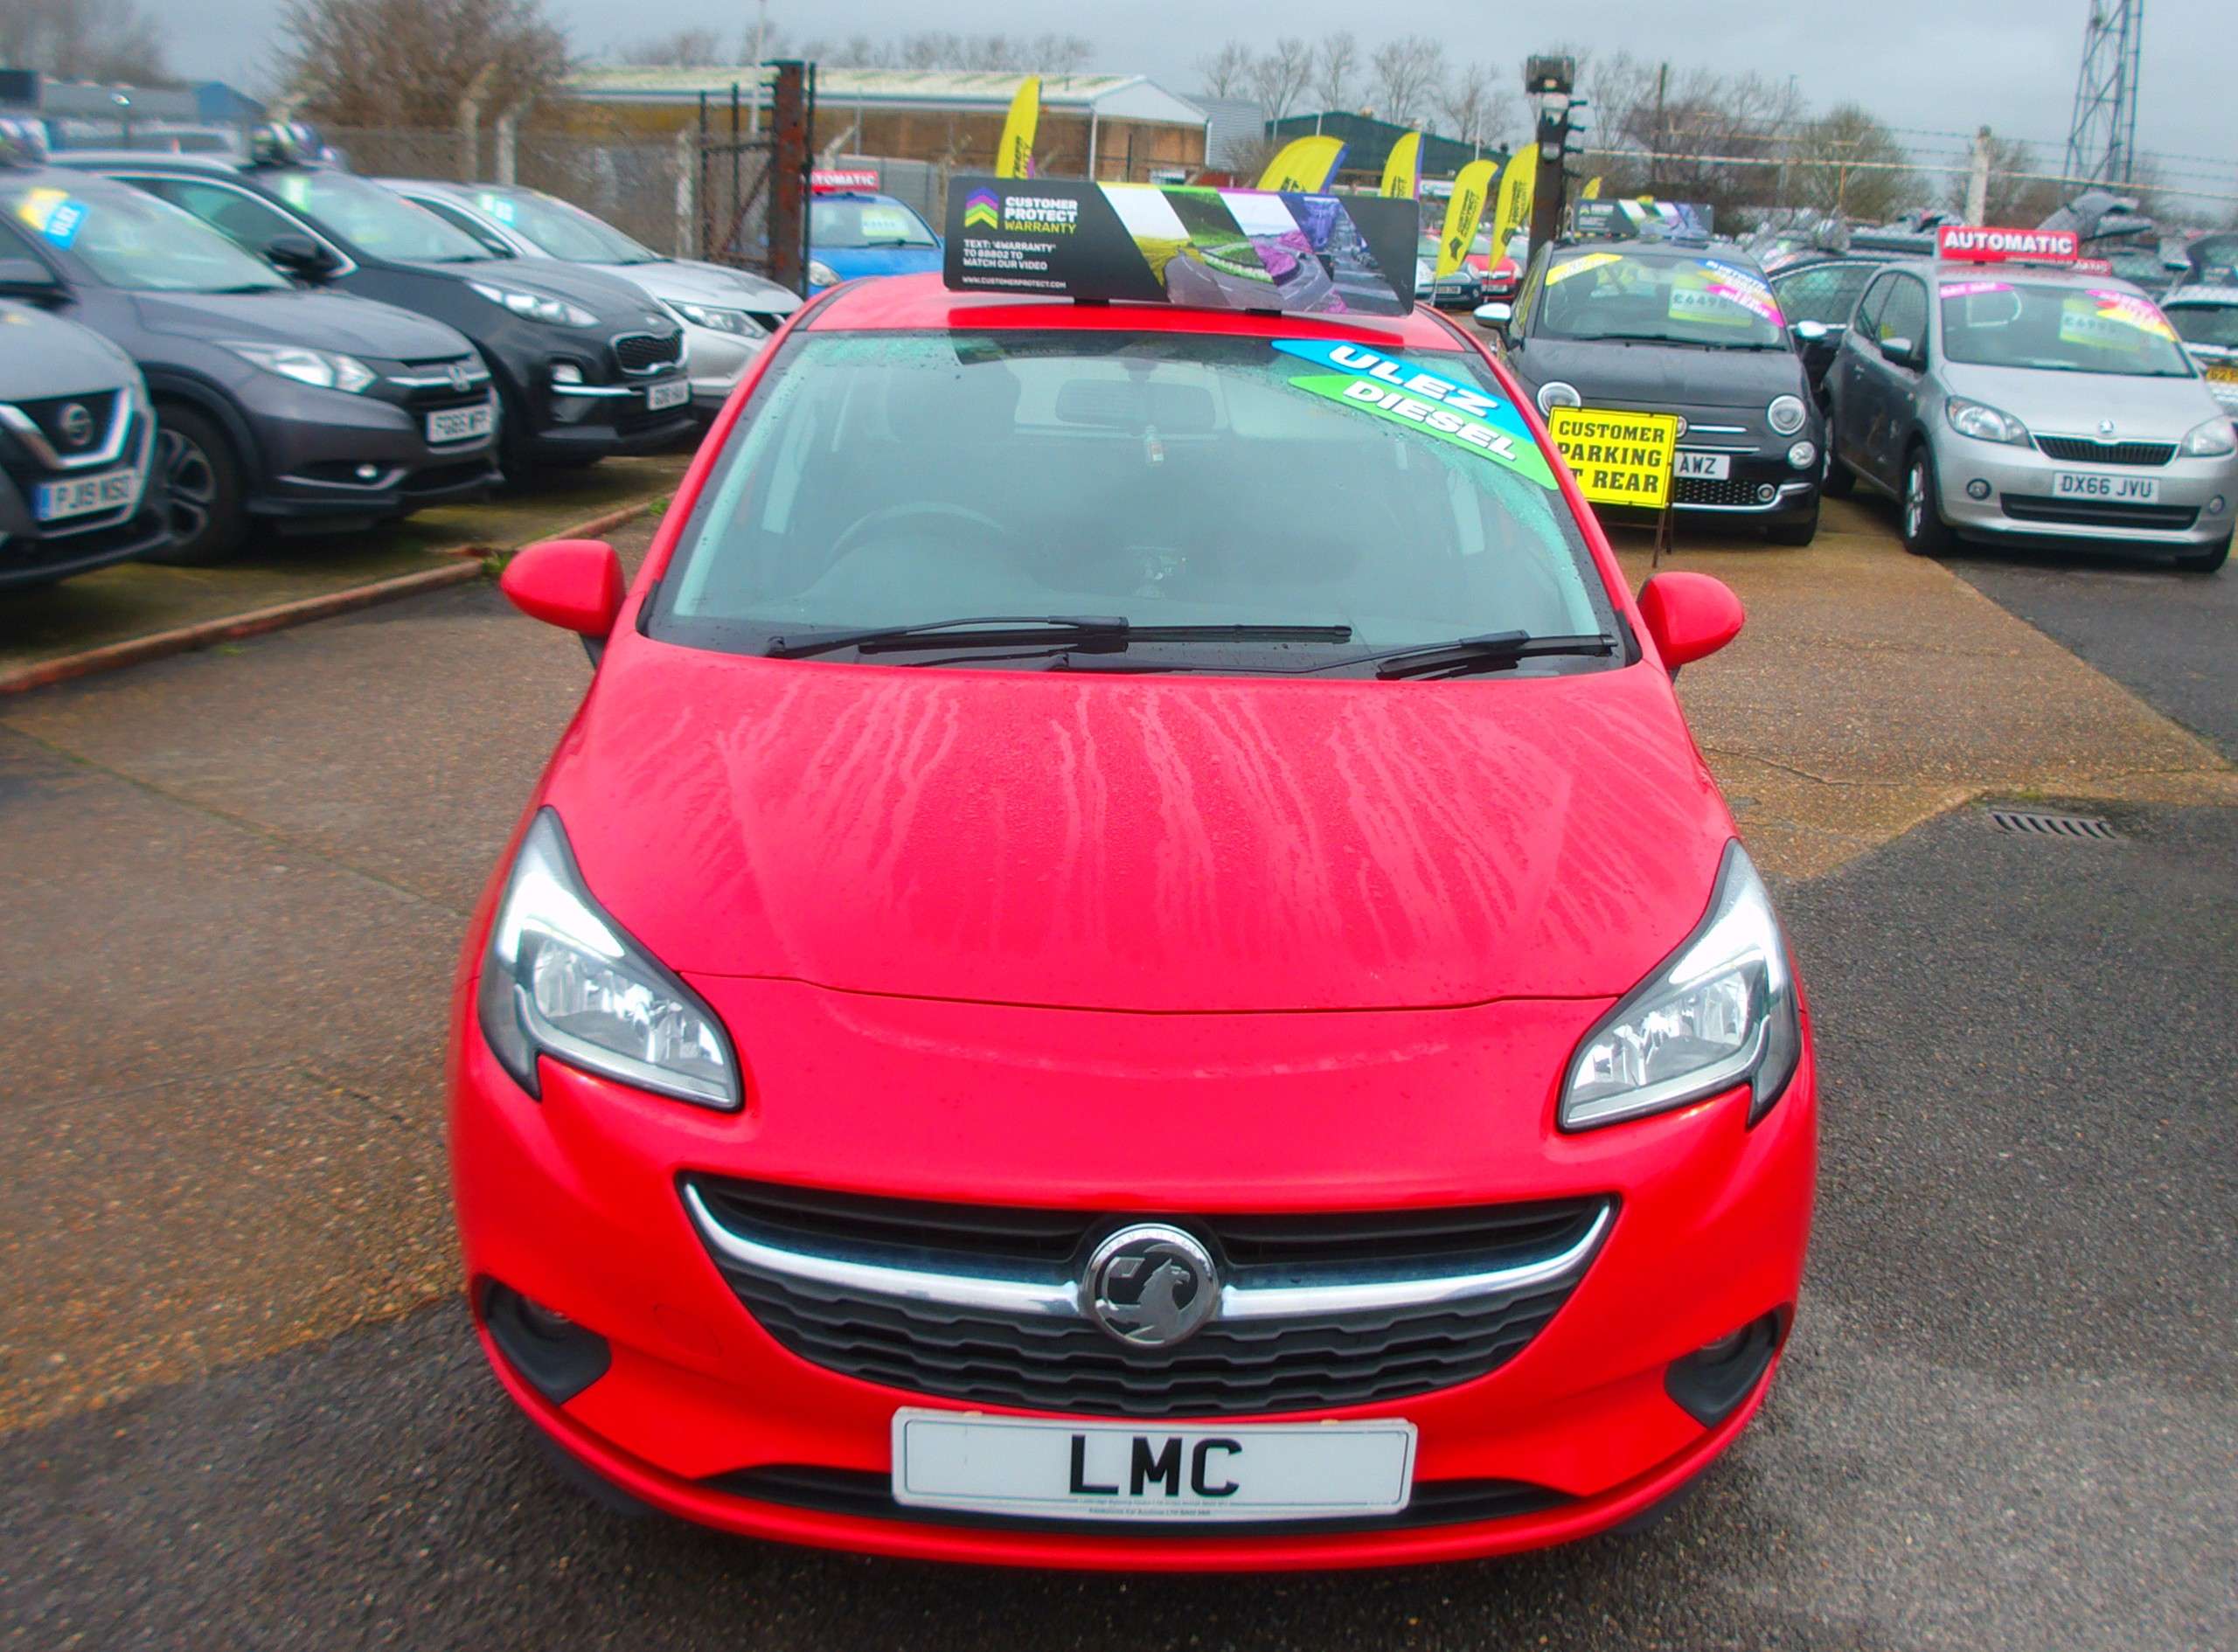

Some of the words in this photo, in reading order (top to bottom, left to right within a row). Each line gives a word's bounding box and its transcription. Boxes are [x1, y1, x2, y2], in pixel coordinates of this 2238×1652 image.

[1004, 208, 1078, 222] PROTECT
[1005, 197, 1078, 211] CUSTOMER
[1004, 220, 1077, 234] WARRANTY
[963, 239, 991, 249] TEXT:
[1943, 231, 2073, 254] AUTOMATIC
[963, 248, 977, 258] TO
[1011, 251, 1024, 260] TO
[963, 258, 997, 268] WATCH
[997, 259, 1018, 269] OUR
[1018, 260, 1047, 271] VIDEO
[1329, 345, 1498, 418] ULEZ
[1343, 380, 1516, 462] DIESEL
[1559, 420, 1665, 443] CUSTOMER
[1557, 442, 1662, 468] PARKING
[1679, 455, 1717, 475] AWZ
[1592, 470, 1658, 493] REAR
[2061, 475, 2110, 495] DX66
[2116, 480, 2151, 497] JVU
[1069, 1434, 1242, 1497] LMC
